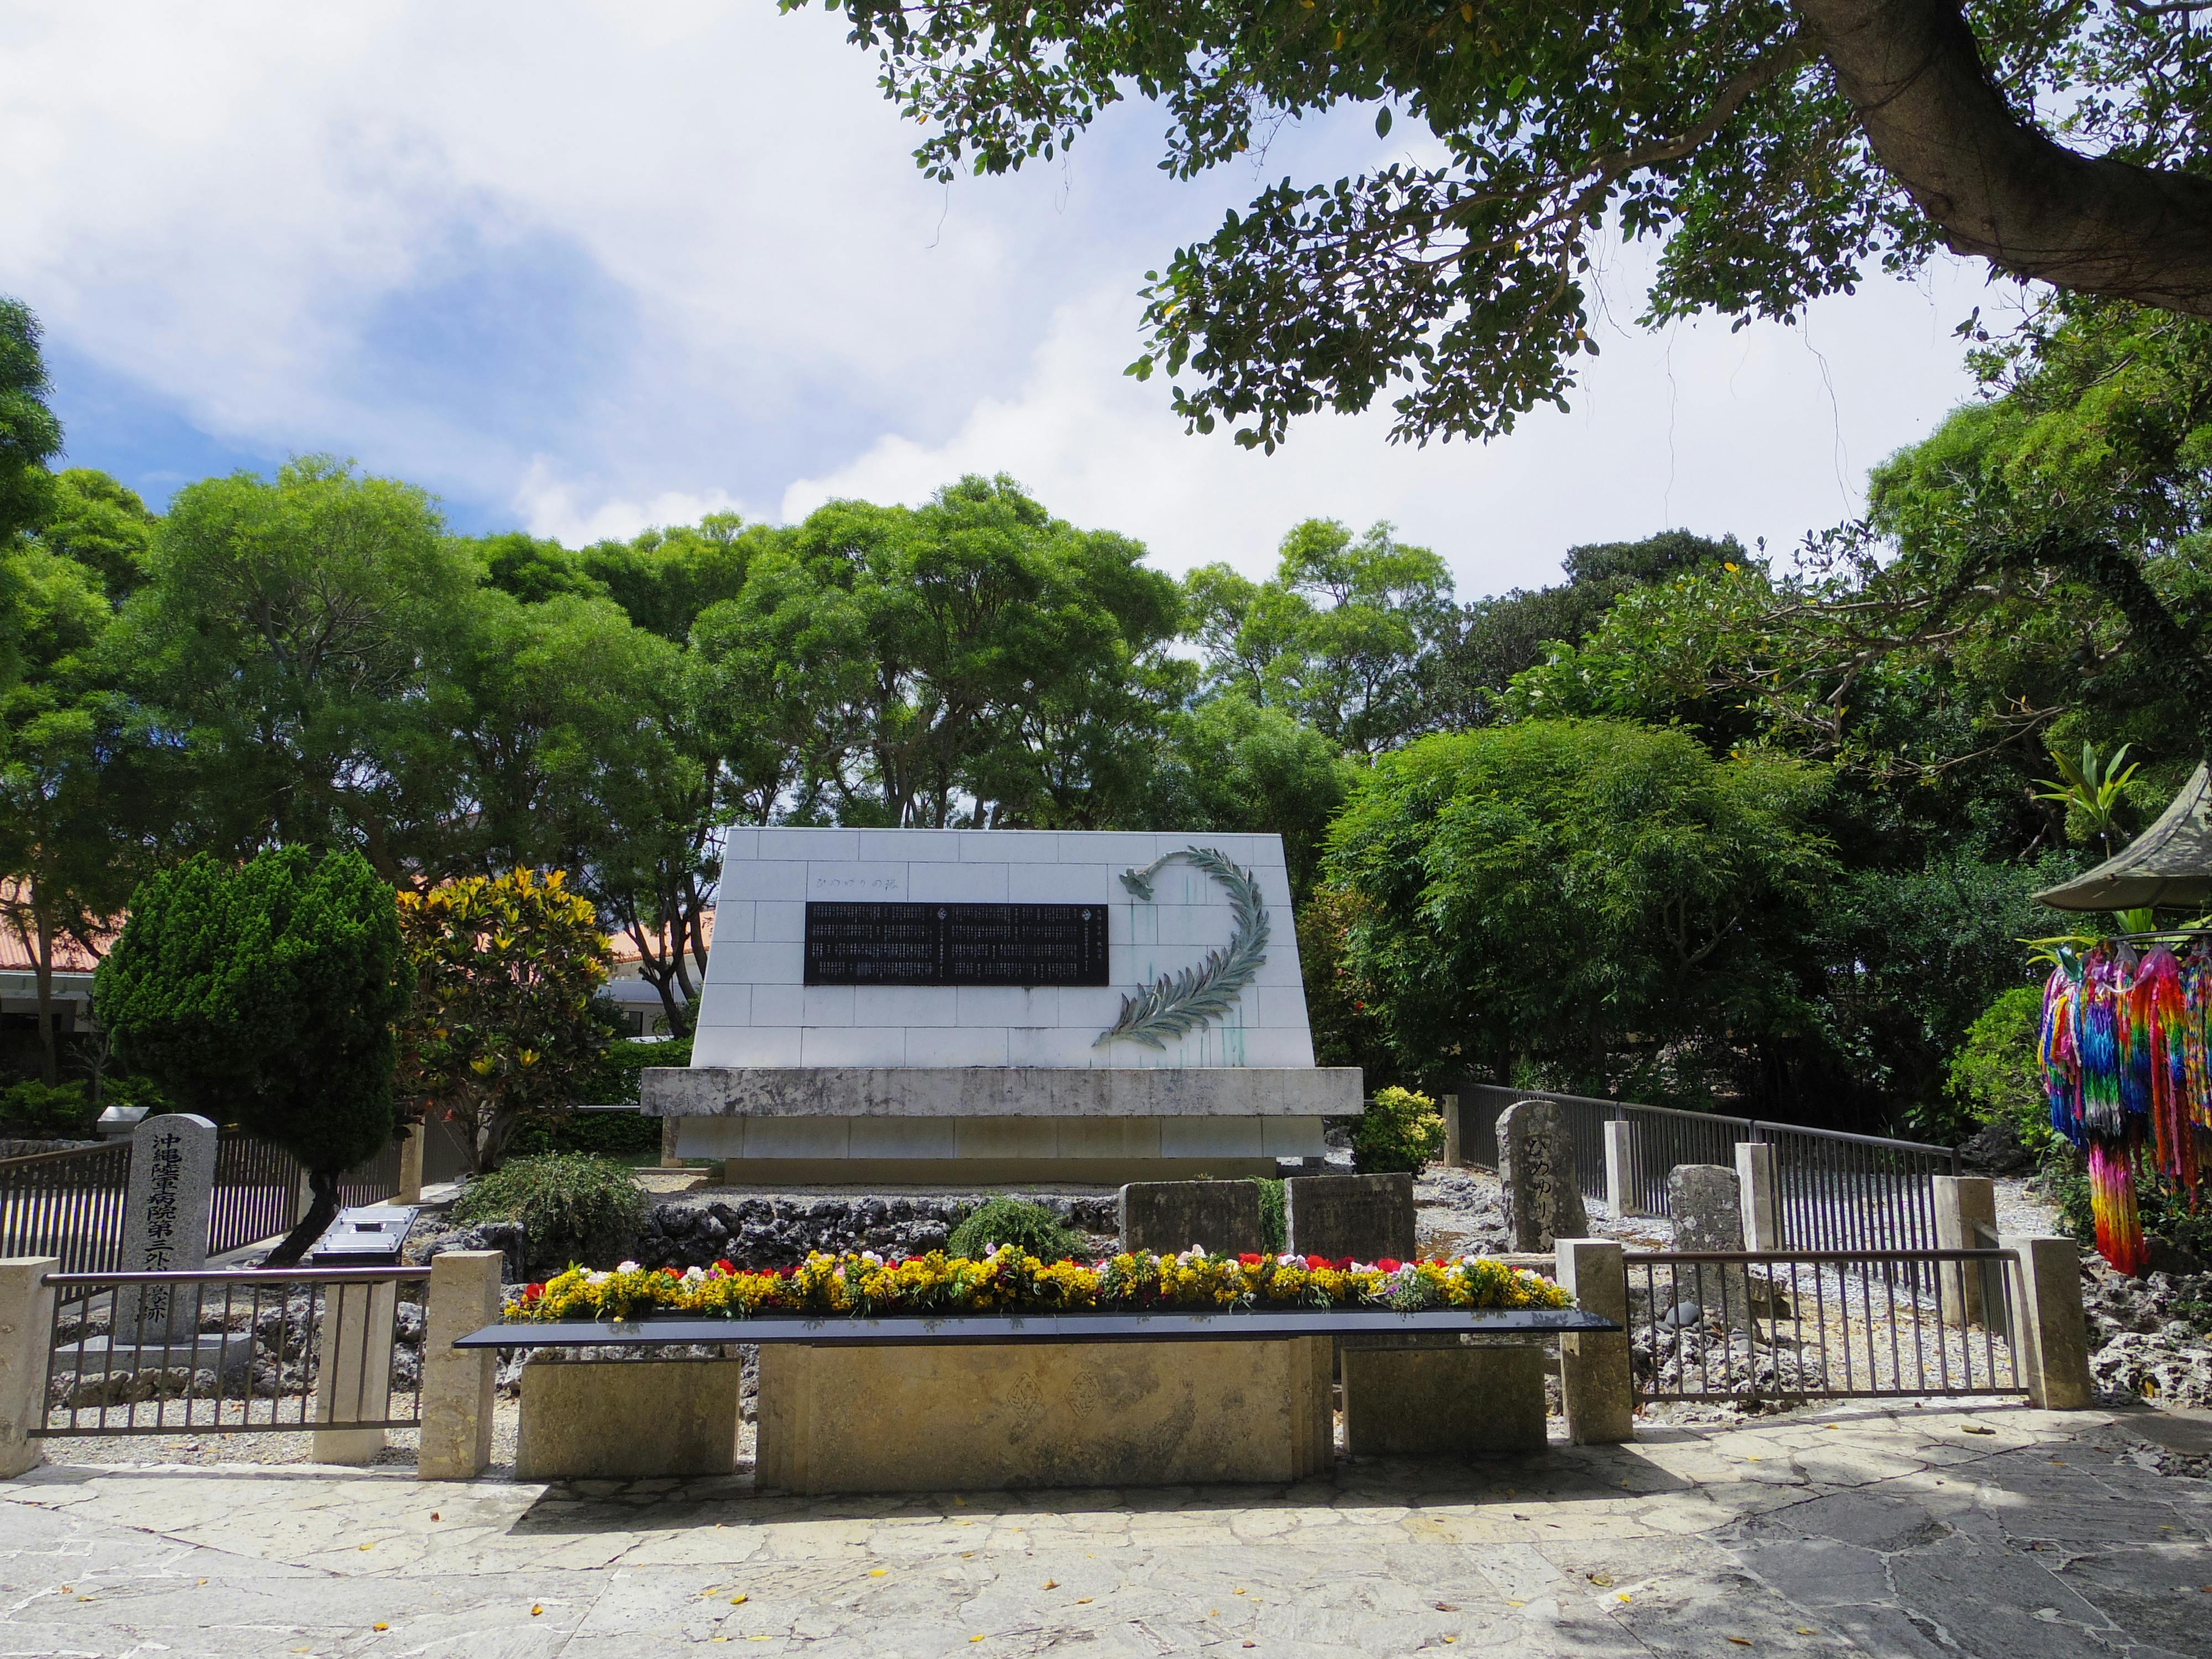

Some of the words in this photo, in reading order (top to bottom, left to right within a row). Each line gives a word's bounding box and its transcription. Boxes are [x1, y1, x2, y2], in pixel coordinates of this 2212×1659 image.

[134, 1133, 182, 1323] 沖縄陸軍病院第三外壕跡
[1530, 1140, 1556, 1253] ひめゆりの
